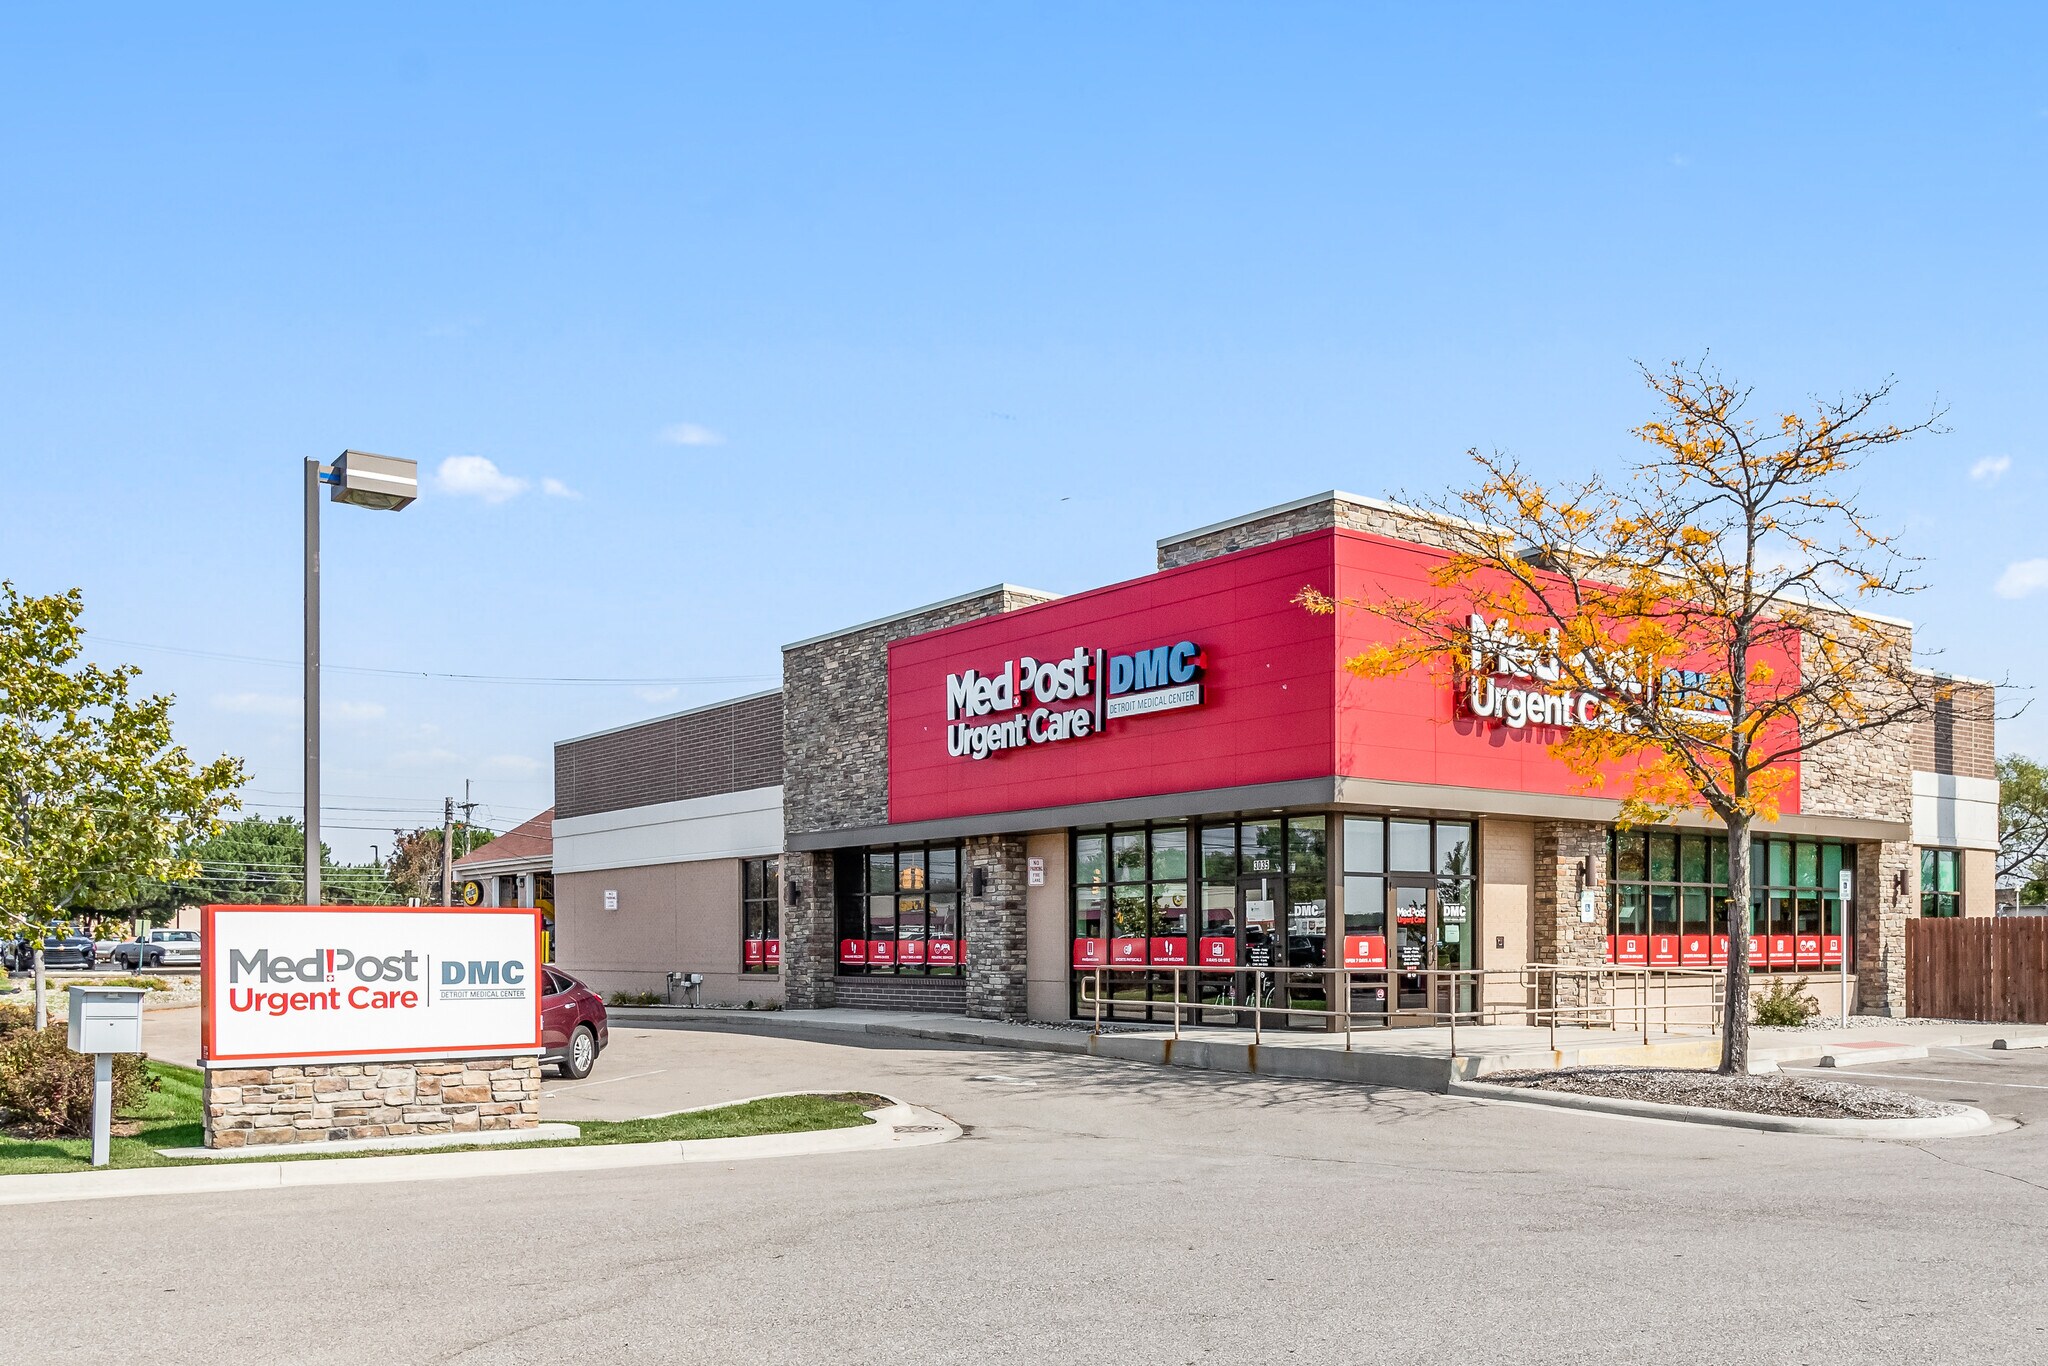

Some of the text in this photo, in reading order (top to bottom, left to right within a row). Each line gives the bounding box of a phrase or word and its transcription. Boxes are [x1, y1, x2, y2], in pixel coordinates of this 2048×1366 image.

[1109, 640, 1197, 695] DMC
[1109, 690, 1195, 715] DETROIT MEDICAL CENTER
[1470, 675, 1574, 729] Urgent
[947, 707, 1091, 760] Urgent Care
[1254, 860, 1269, 870] 3035
[1294, 905, 1319, 916] DMC
[1443, 905, 1467, 917] DMC
[441, 959, 525, 985] DMC
[229, 985, 419, 1016] Urgent Care
[440, 990, 526, 999] DETROIT MEDICAL CENTER
